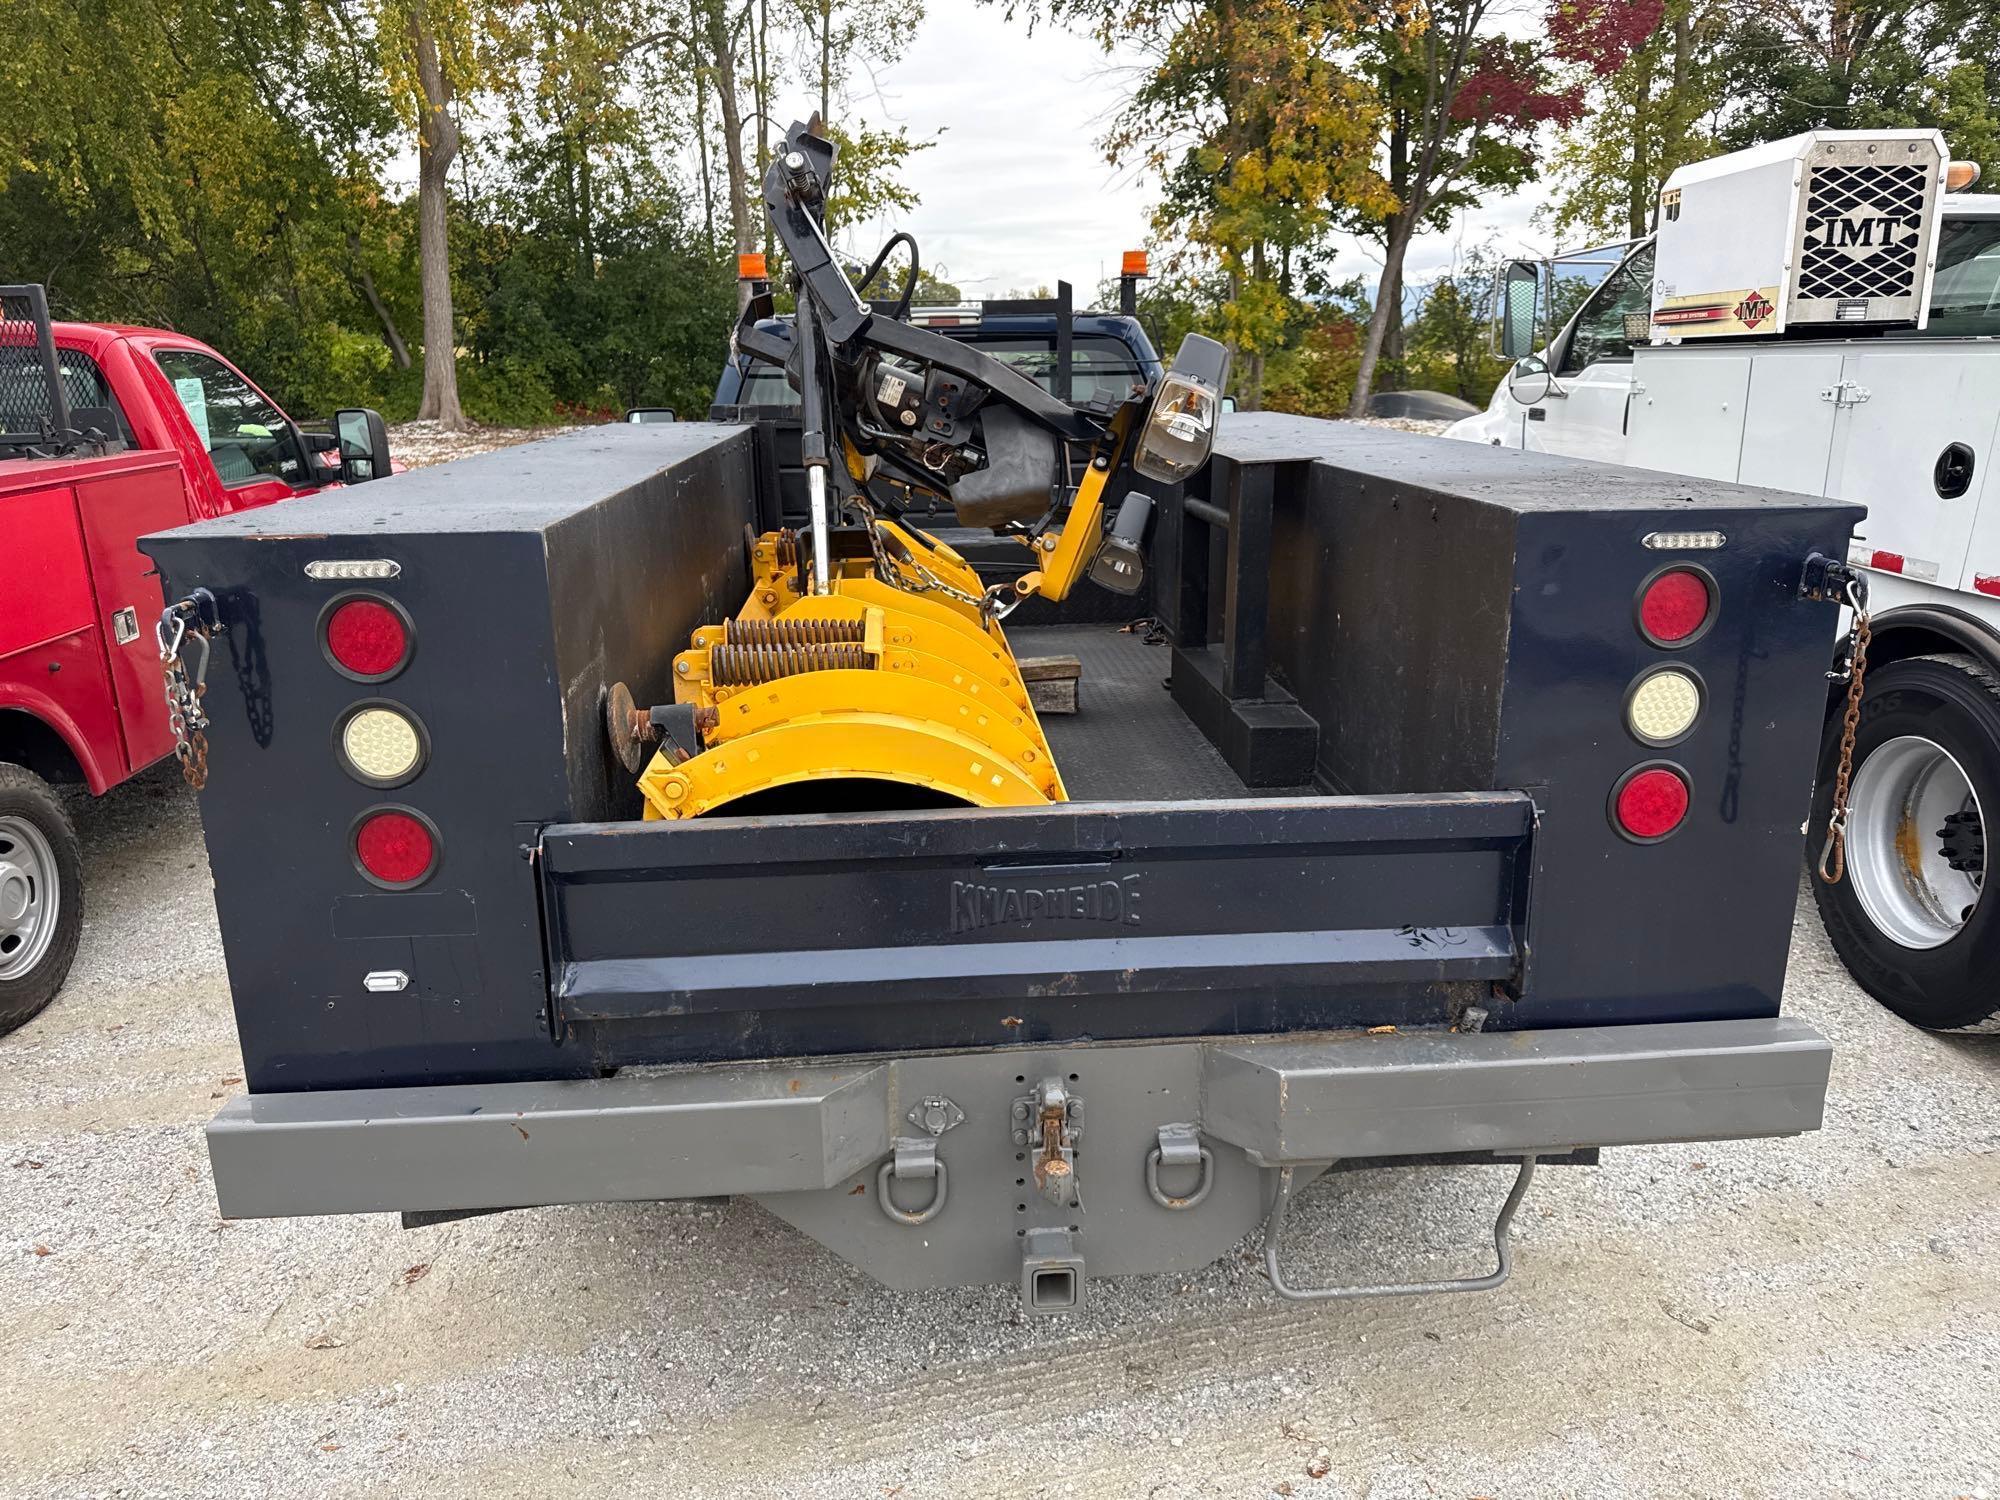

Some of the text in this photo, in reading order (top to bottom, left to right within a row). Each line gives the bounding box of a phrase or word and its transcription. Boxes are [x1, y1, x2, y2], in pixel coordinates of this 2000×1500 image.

[1822, 217, 1901, 247] IMT
[1738, 300, 1770, 321] IMT
[950, 873, 1142, 935] KNAPHEIDE
